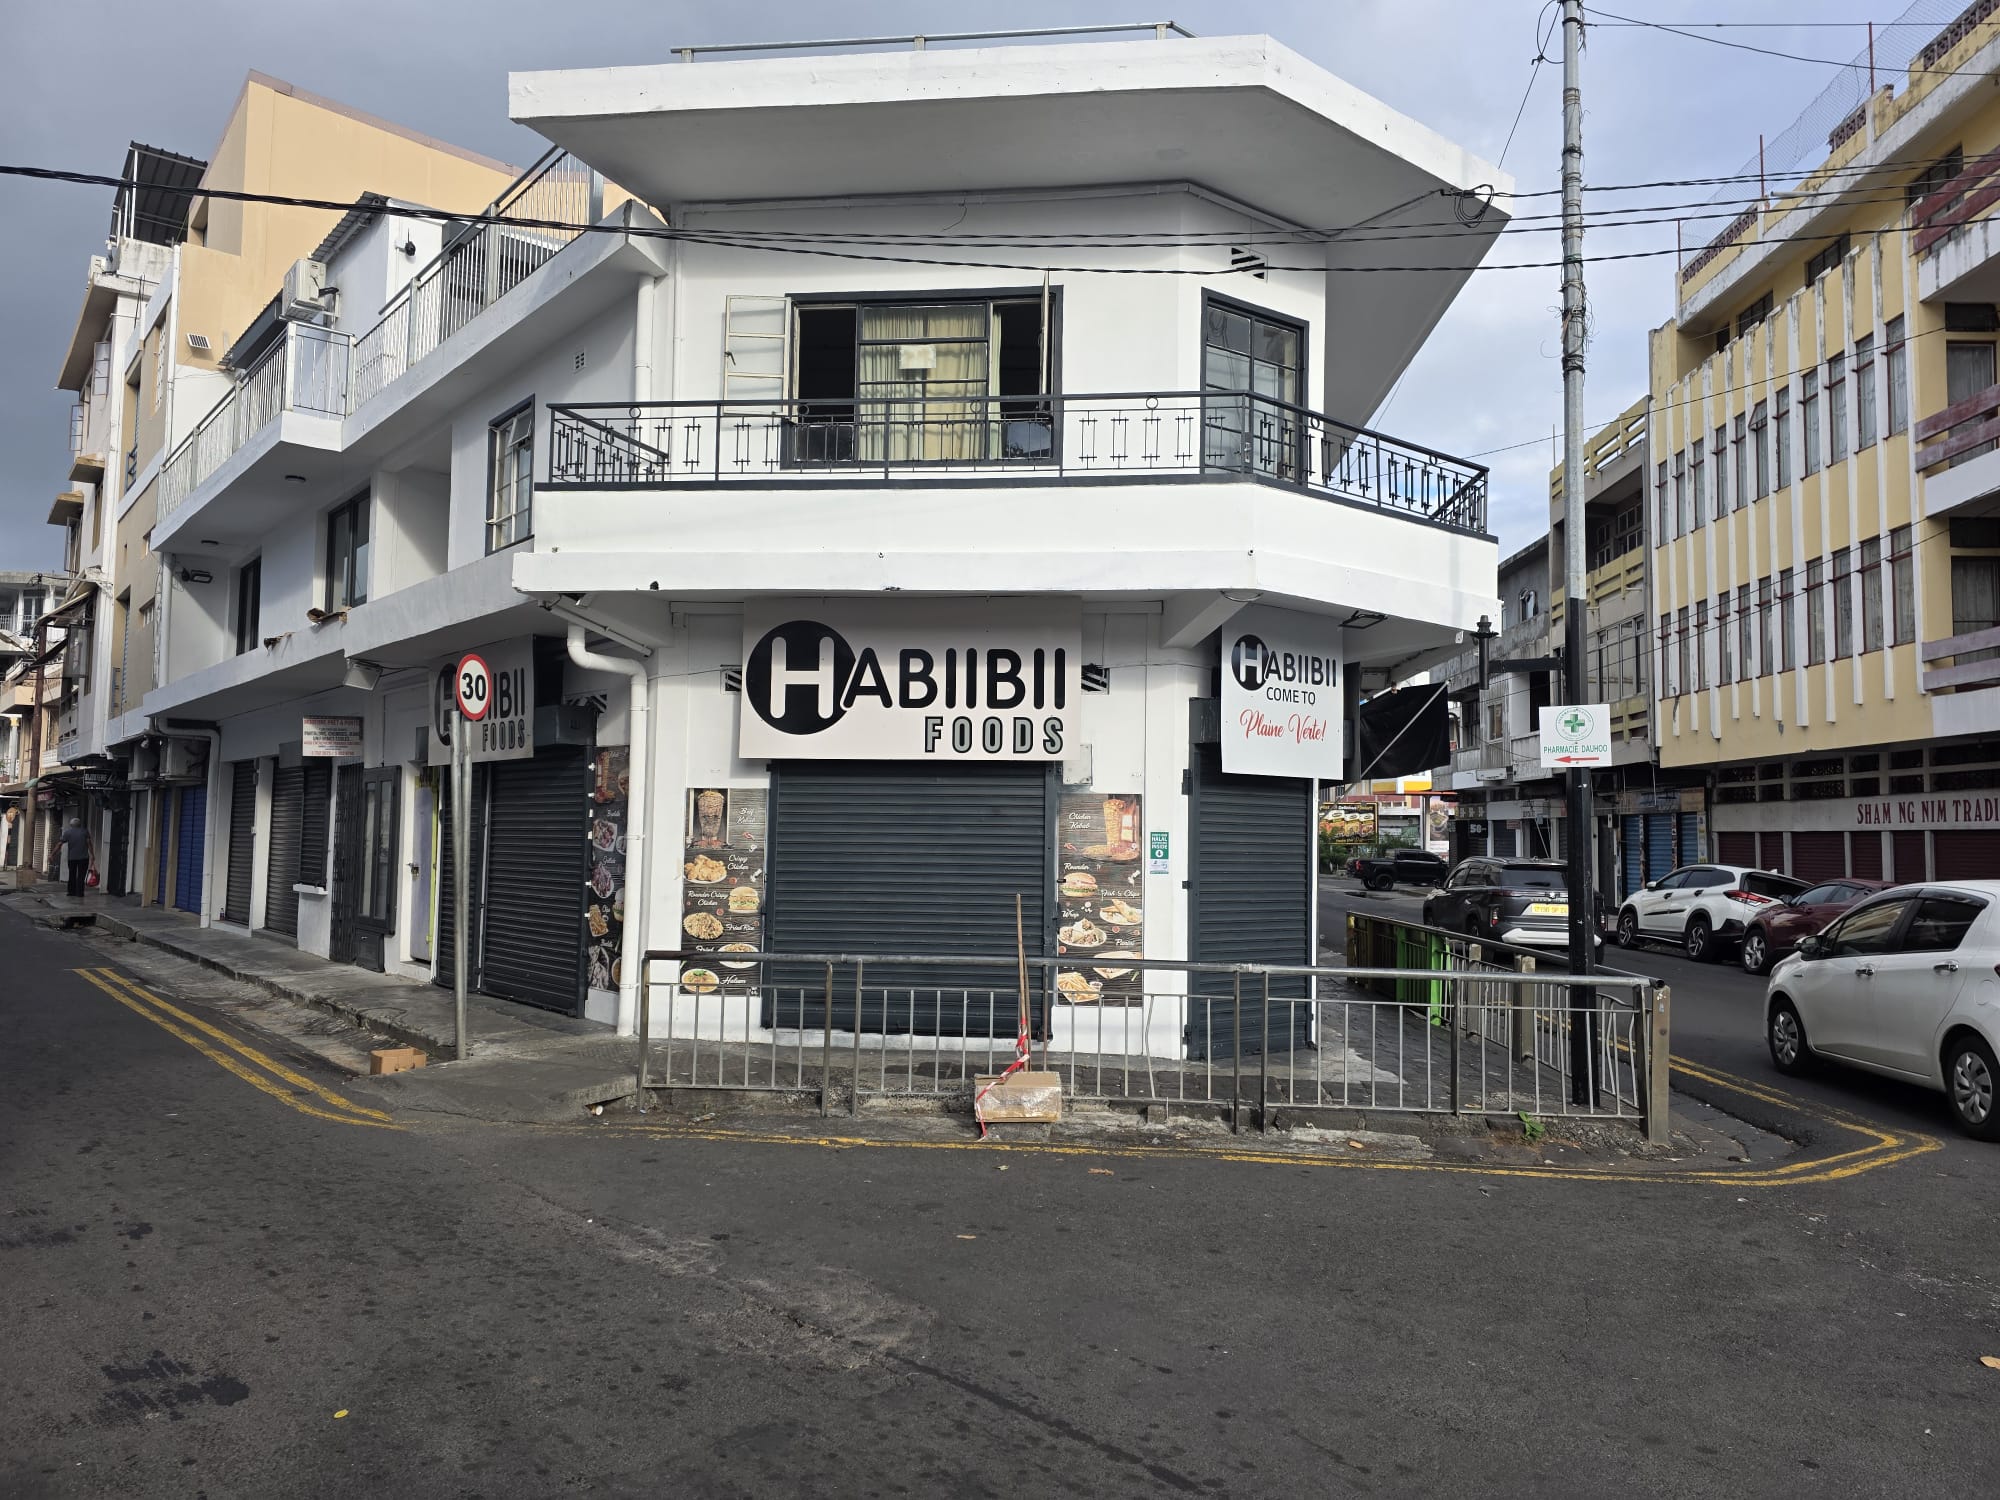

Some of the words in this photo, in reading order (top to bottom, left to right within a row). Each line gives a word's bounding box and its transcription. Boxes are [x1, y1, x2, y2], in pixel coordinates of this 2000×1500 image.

[1239, 641, 1337, 687] HABIIBII
[461, 672, 487, 701] 30
[768, 635, 1066, 720] HABIIBII
[1266, 686, 1300, 703] COME
[1301, 690, 1316, 705] TO
[482, 718, 525, 753] FOODS
[924, 715, 1064, 754] FOODS
[1240, 709, 1284, 739] Plaine
[1288, 713, 1327, 744] Verte!
[1543, 745, 1579, 754] PHARMACIE
[1581, 744, 1608, 753] DAUHOO
[1068, 812, 1091, 820] Chicken
[1857, 802, 1892, 824] SHAM
[1898, 801, 1915, 823] NG
[1921, 799, 1947, 822] NIM
[1069, 821, 1090, 829] Kebab
[728, 854, 748, 863] Crispy
[1064, 862, 1089, 870] Rounder
[697, 898, 718, 906] Chicken
[710, 890, 729, 899] Crispy
